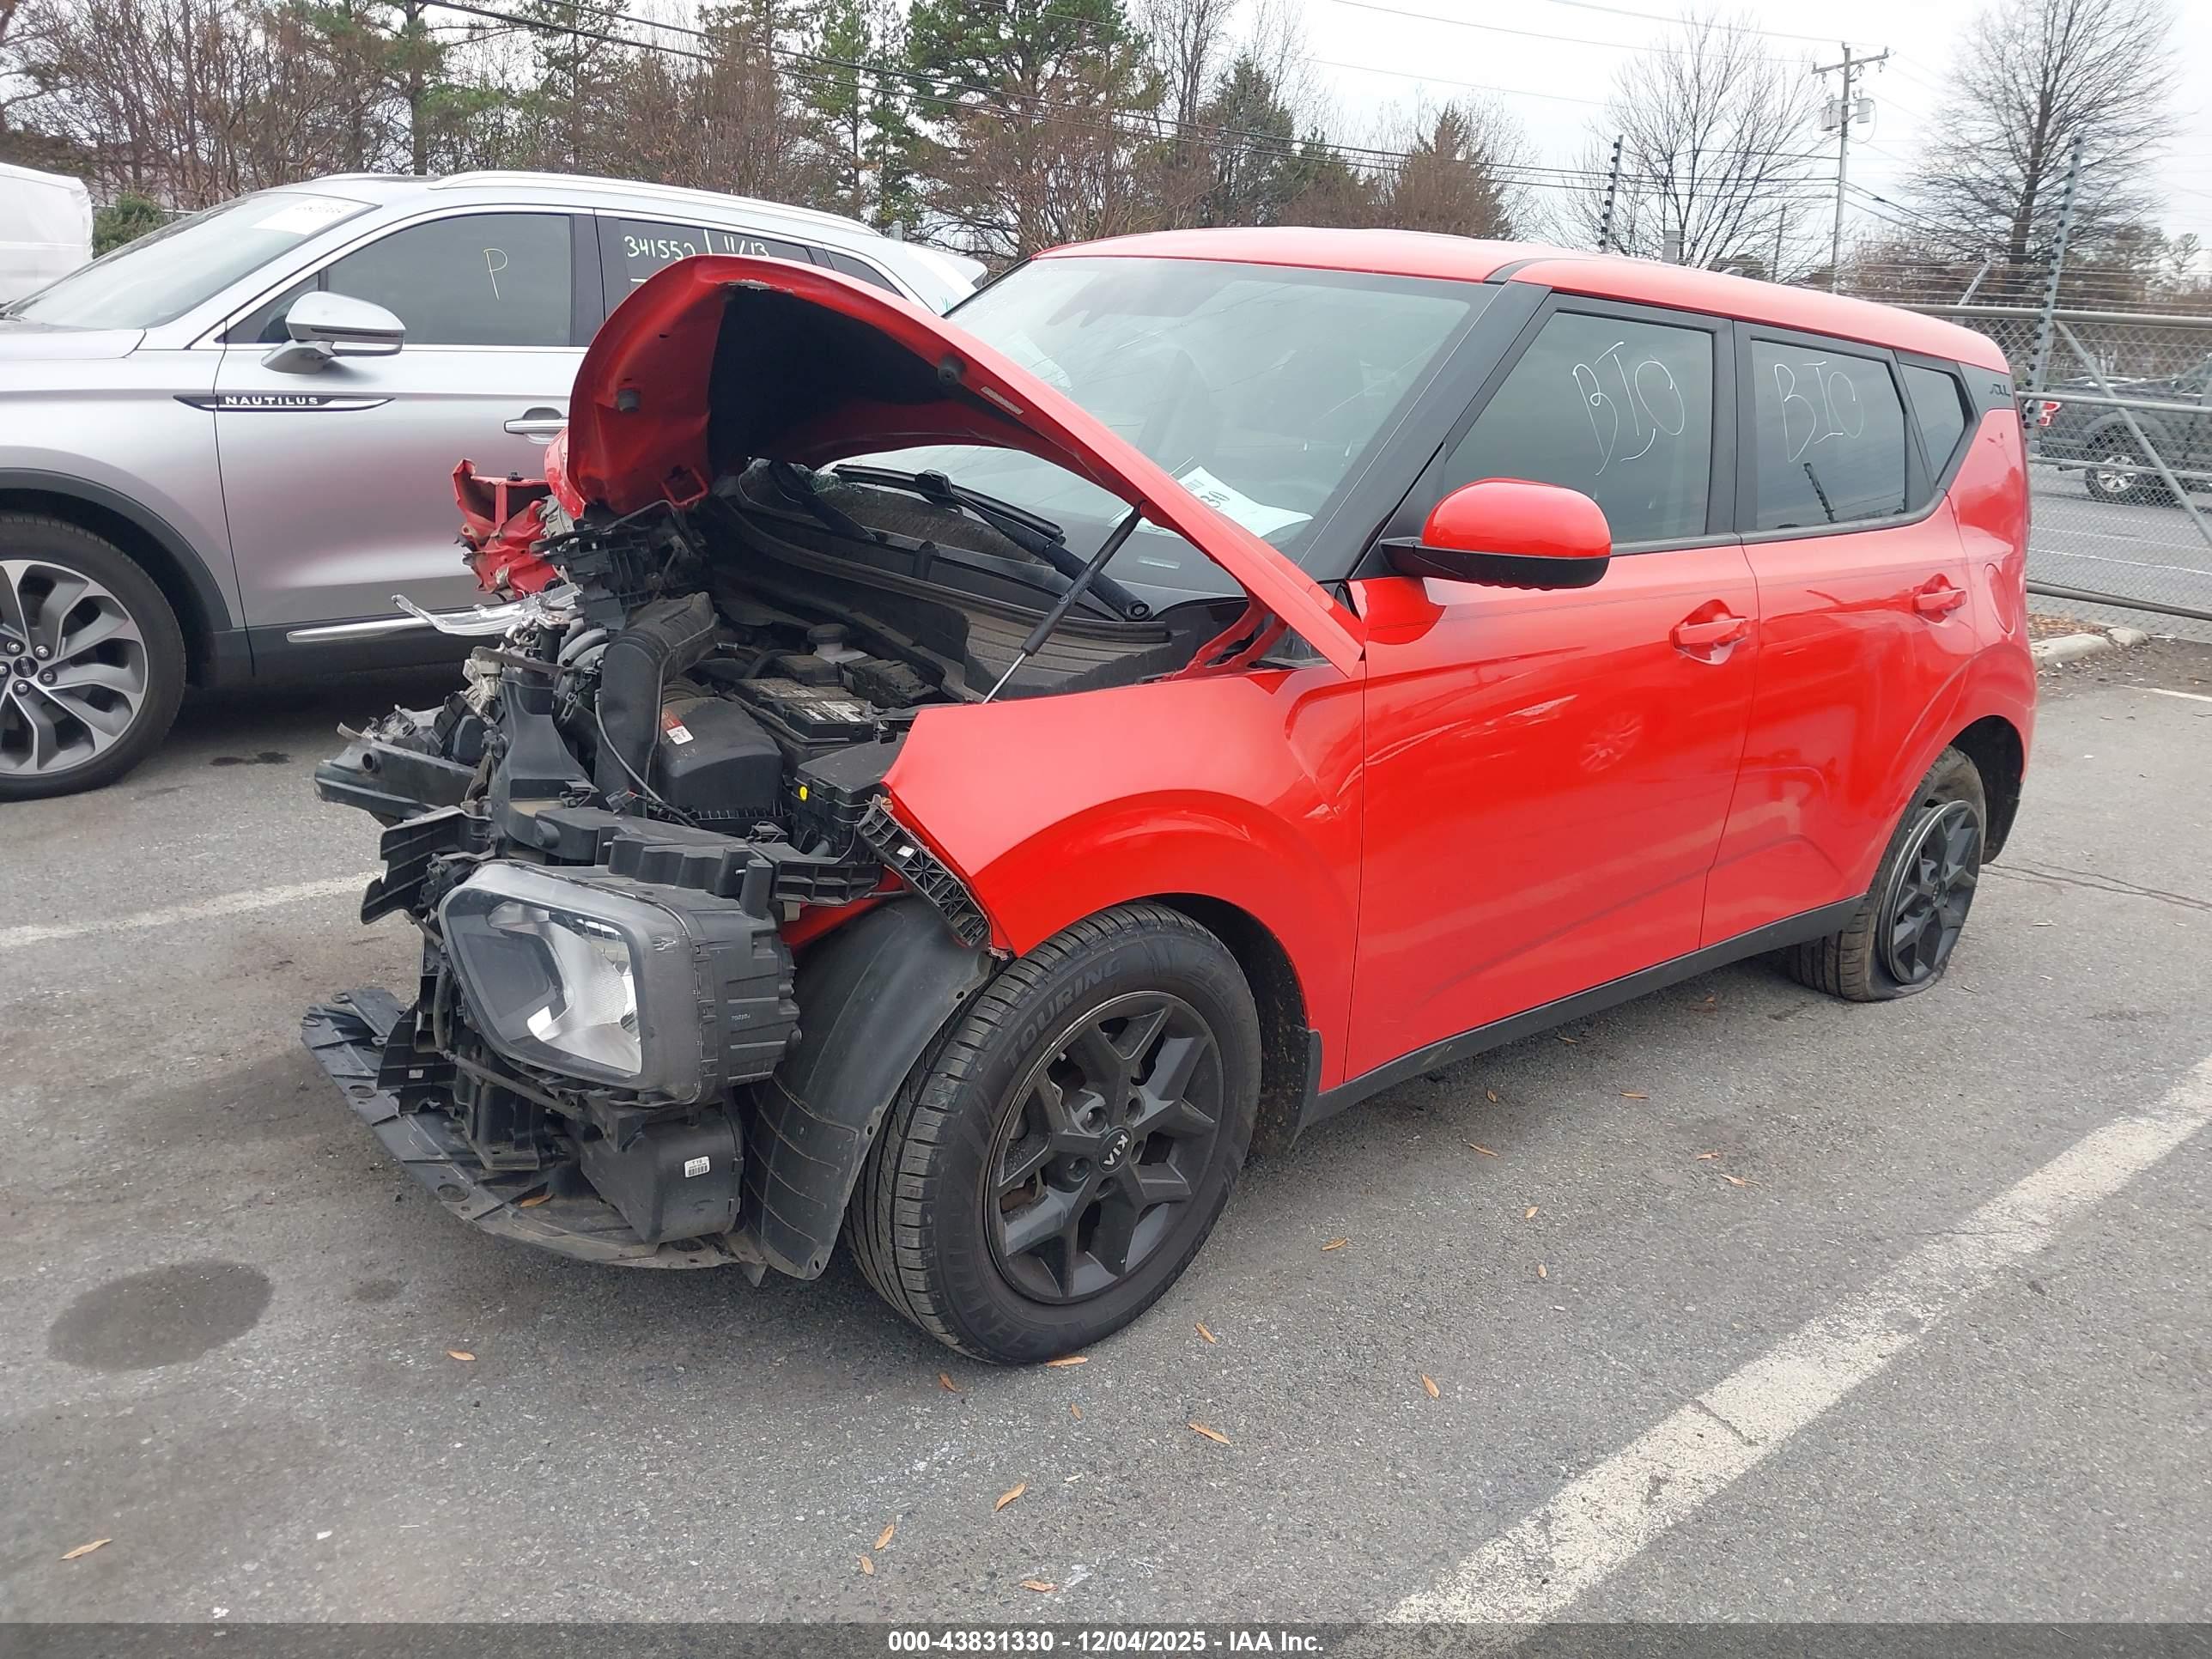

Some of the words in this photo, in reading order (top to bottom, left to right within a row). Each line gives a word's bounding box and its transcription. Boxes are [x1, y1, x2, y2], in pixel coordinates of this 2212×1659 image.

[723, 234, 770, 258] 11/13
[481, 246, 508, 301] P
[224, 396, 319, 406] NAUTILUS
[1003, 957, 1121, 1070] TOURING
[1102, 1133, 1129, 1168] KIA
